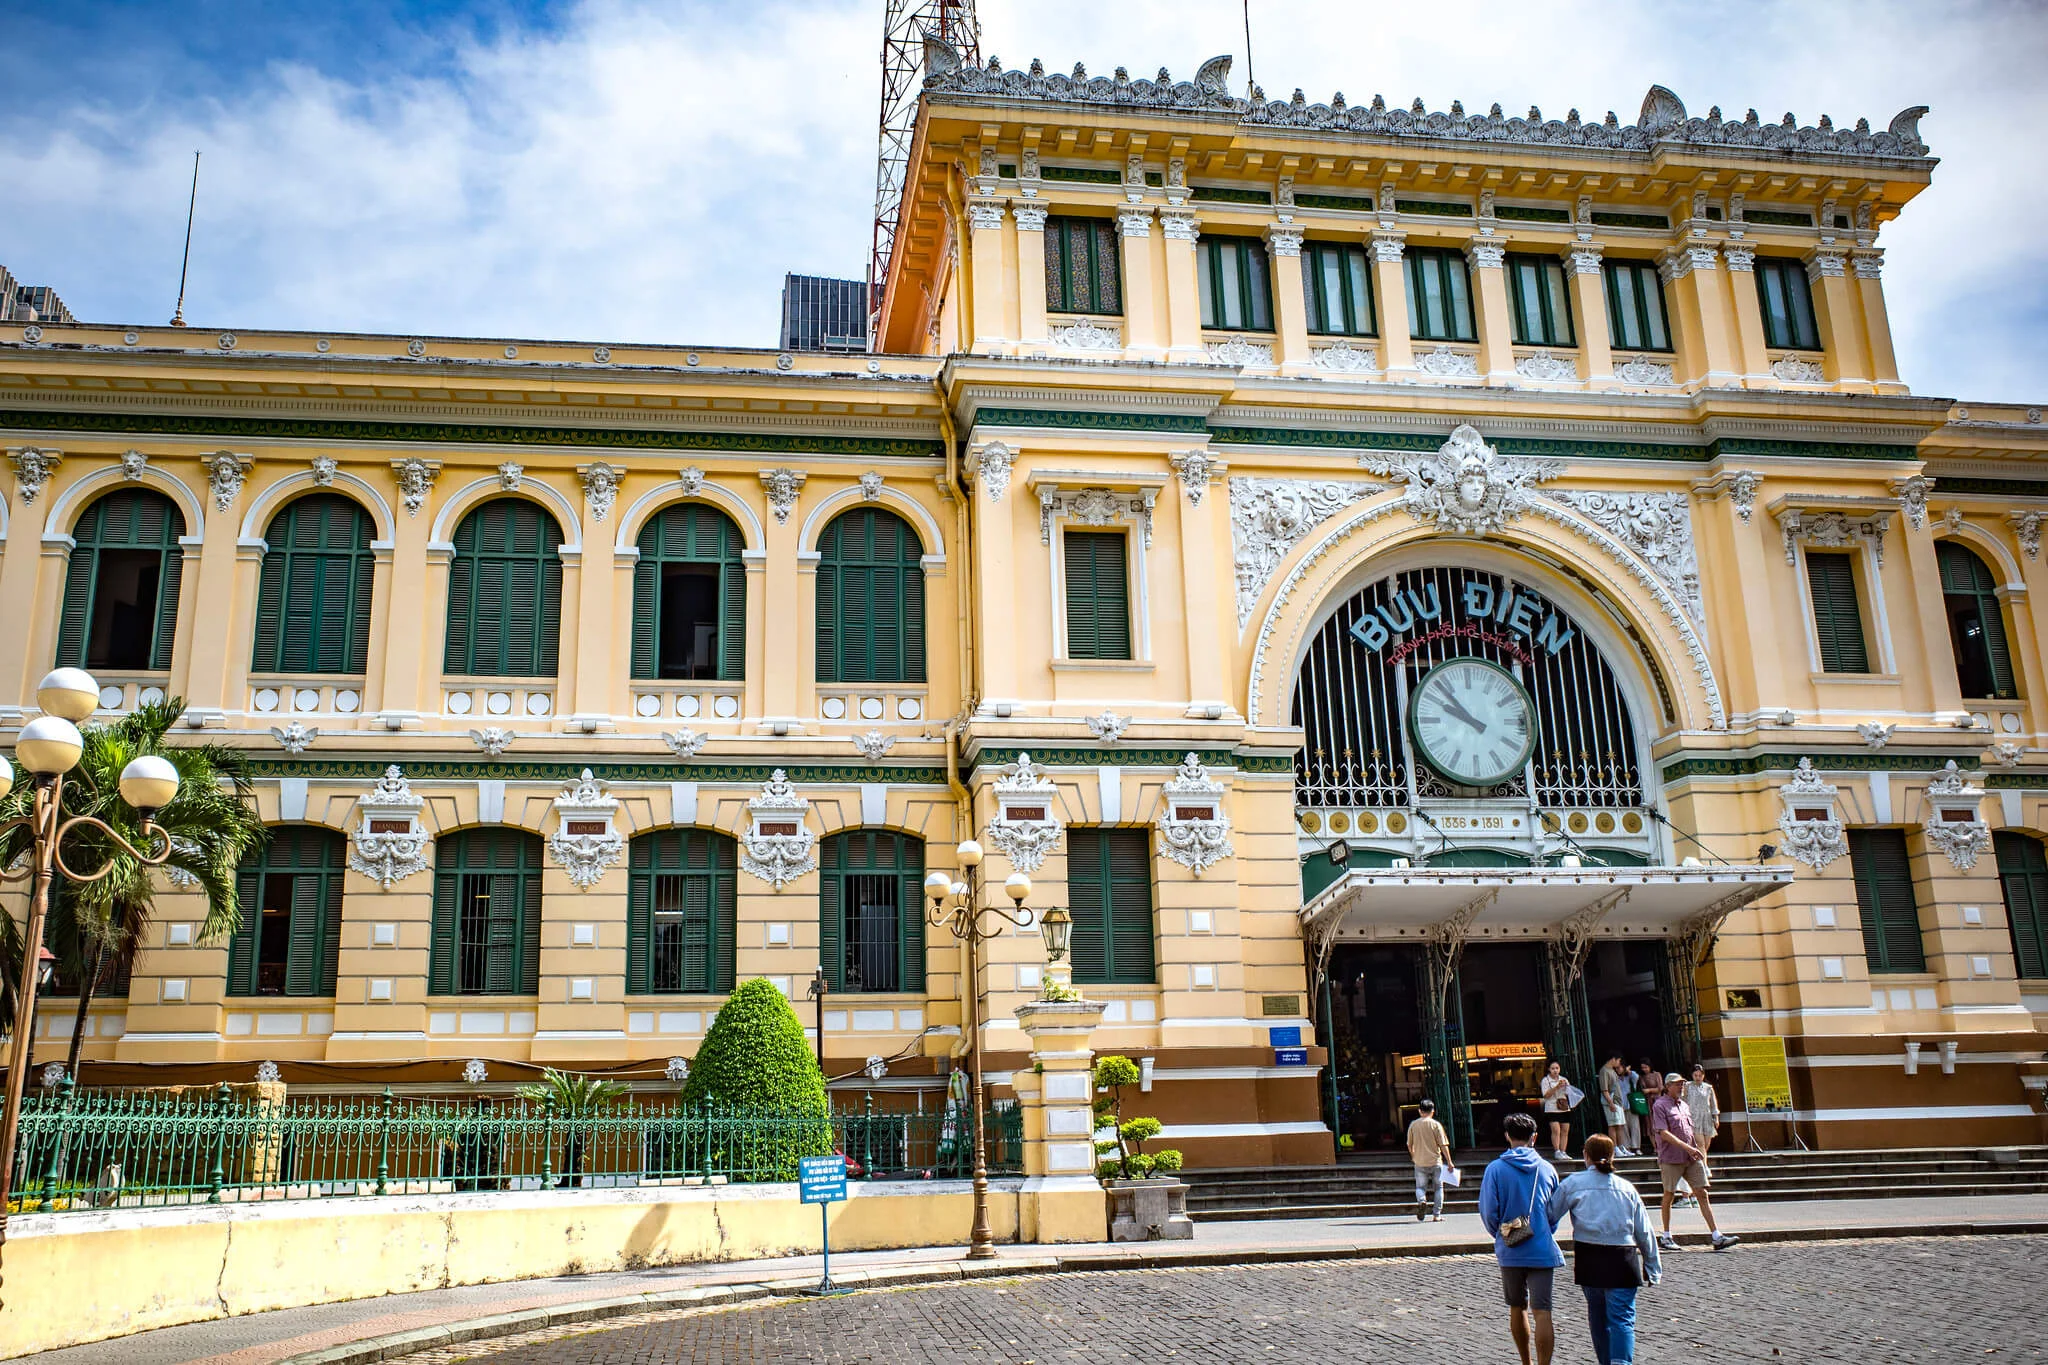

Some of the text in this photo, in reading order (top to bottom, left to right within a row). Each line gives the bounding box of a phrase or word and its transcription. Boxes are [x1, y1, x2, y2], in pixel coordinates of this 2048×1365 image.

[1463, 581, 1576, 656] ĐIỆN
[1427, 621, 1453, 641] PHỐ
[1457, 621, 1477, 637] HỒ
[1015, 809, 1036, 817] VOLTA
[1441, 816, 1504, 828] 1886 1891
[1489, 1046, 1520, 1055] COFFEE
